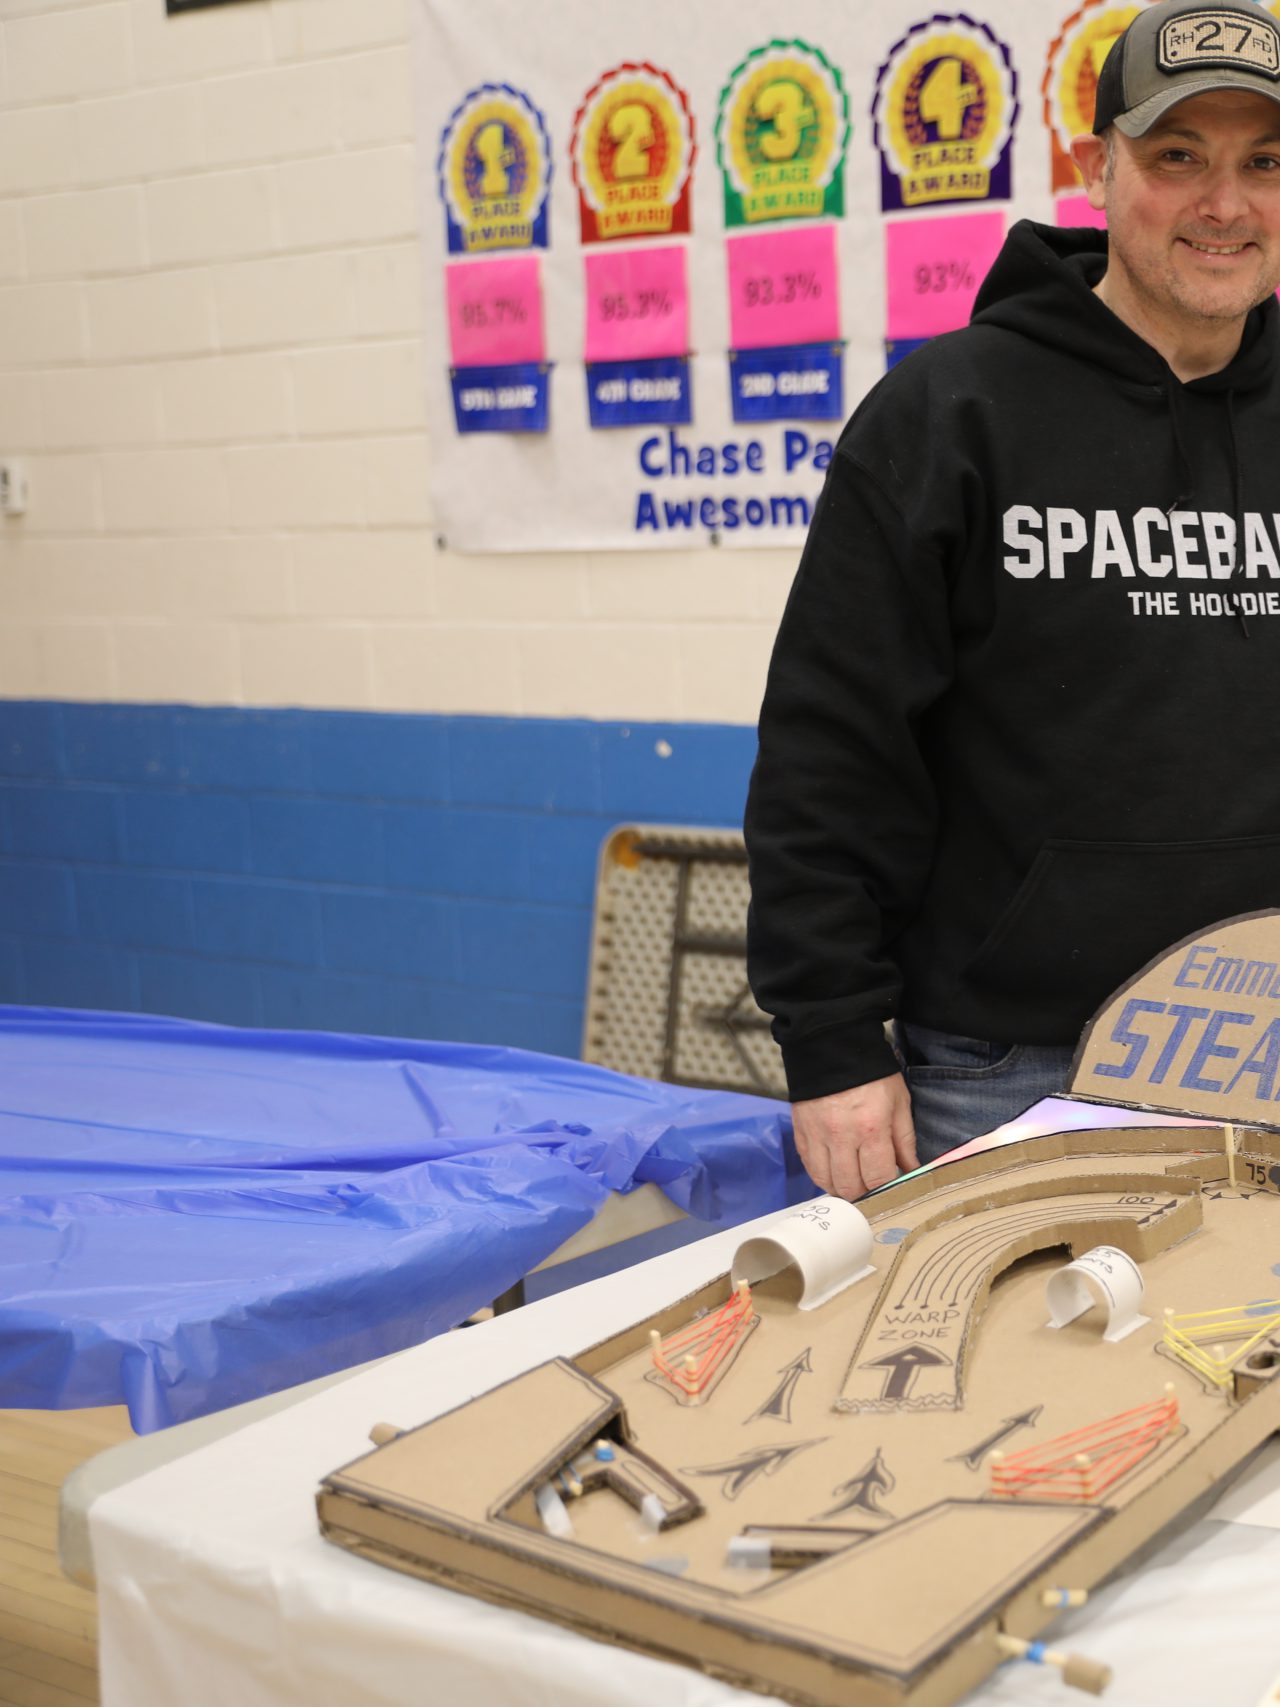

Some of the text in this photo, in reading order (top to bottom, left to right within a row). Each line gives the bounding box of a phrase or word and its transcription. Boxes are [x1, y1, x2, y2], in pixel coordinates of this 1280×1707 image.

[1194, 20, 1252, 53] 27
[912, 147, 976, 168] PLACE
[754, 166, 811, 187] PLACE
[909, 173, 986, 193] AWARD
[607, 184, 661, 204] PLACE
[749, 191, 818, 211] AWARD
[471, 200, 520, 219] PLACE
[603, 209, 670, 228] AWARD
[469, 222, 531, 243] AWARD
[914, 261, 975, 295] 93%
[640, 429, 833, 477] Chase Pa
[636, 492, 815, 530] Awesom
[1128, 592, 1180, 616] THE
[1245, 1162, 1267, 1186] 75
[1116, 1195, 1156, 1205] 100
[885, 1309, 961, 1325] WARP
[877, 1326, 952, 1341] ZONE
